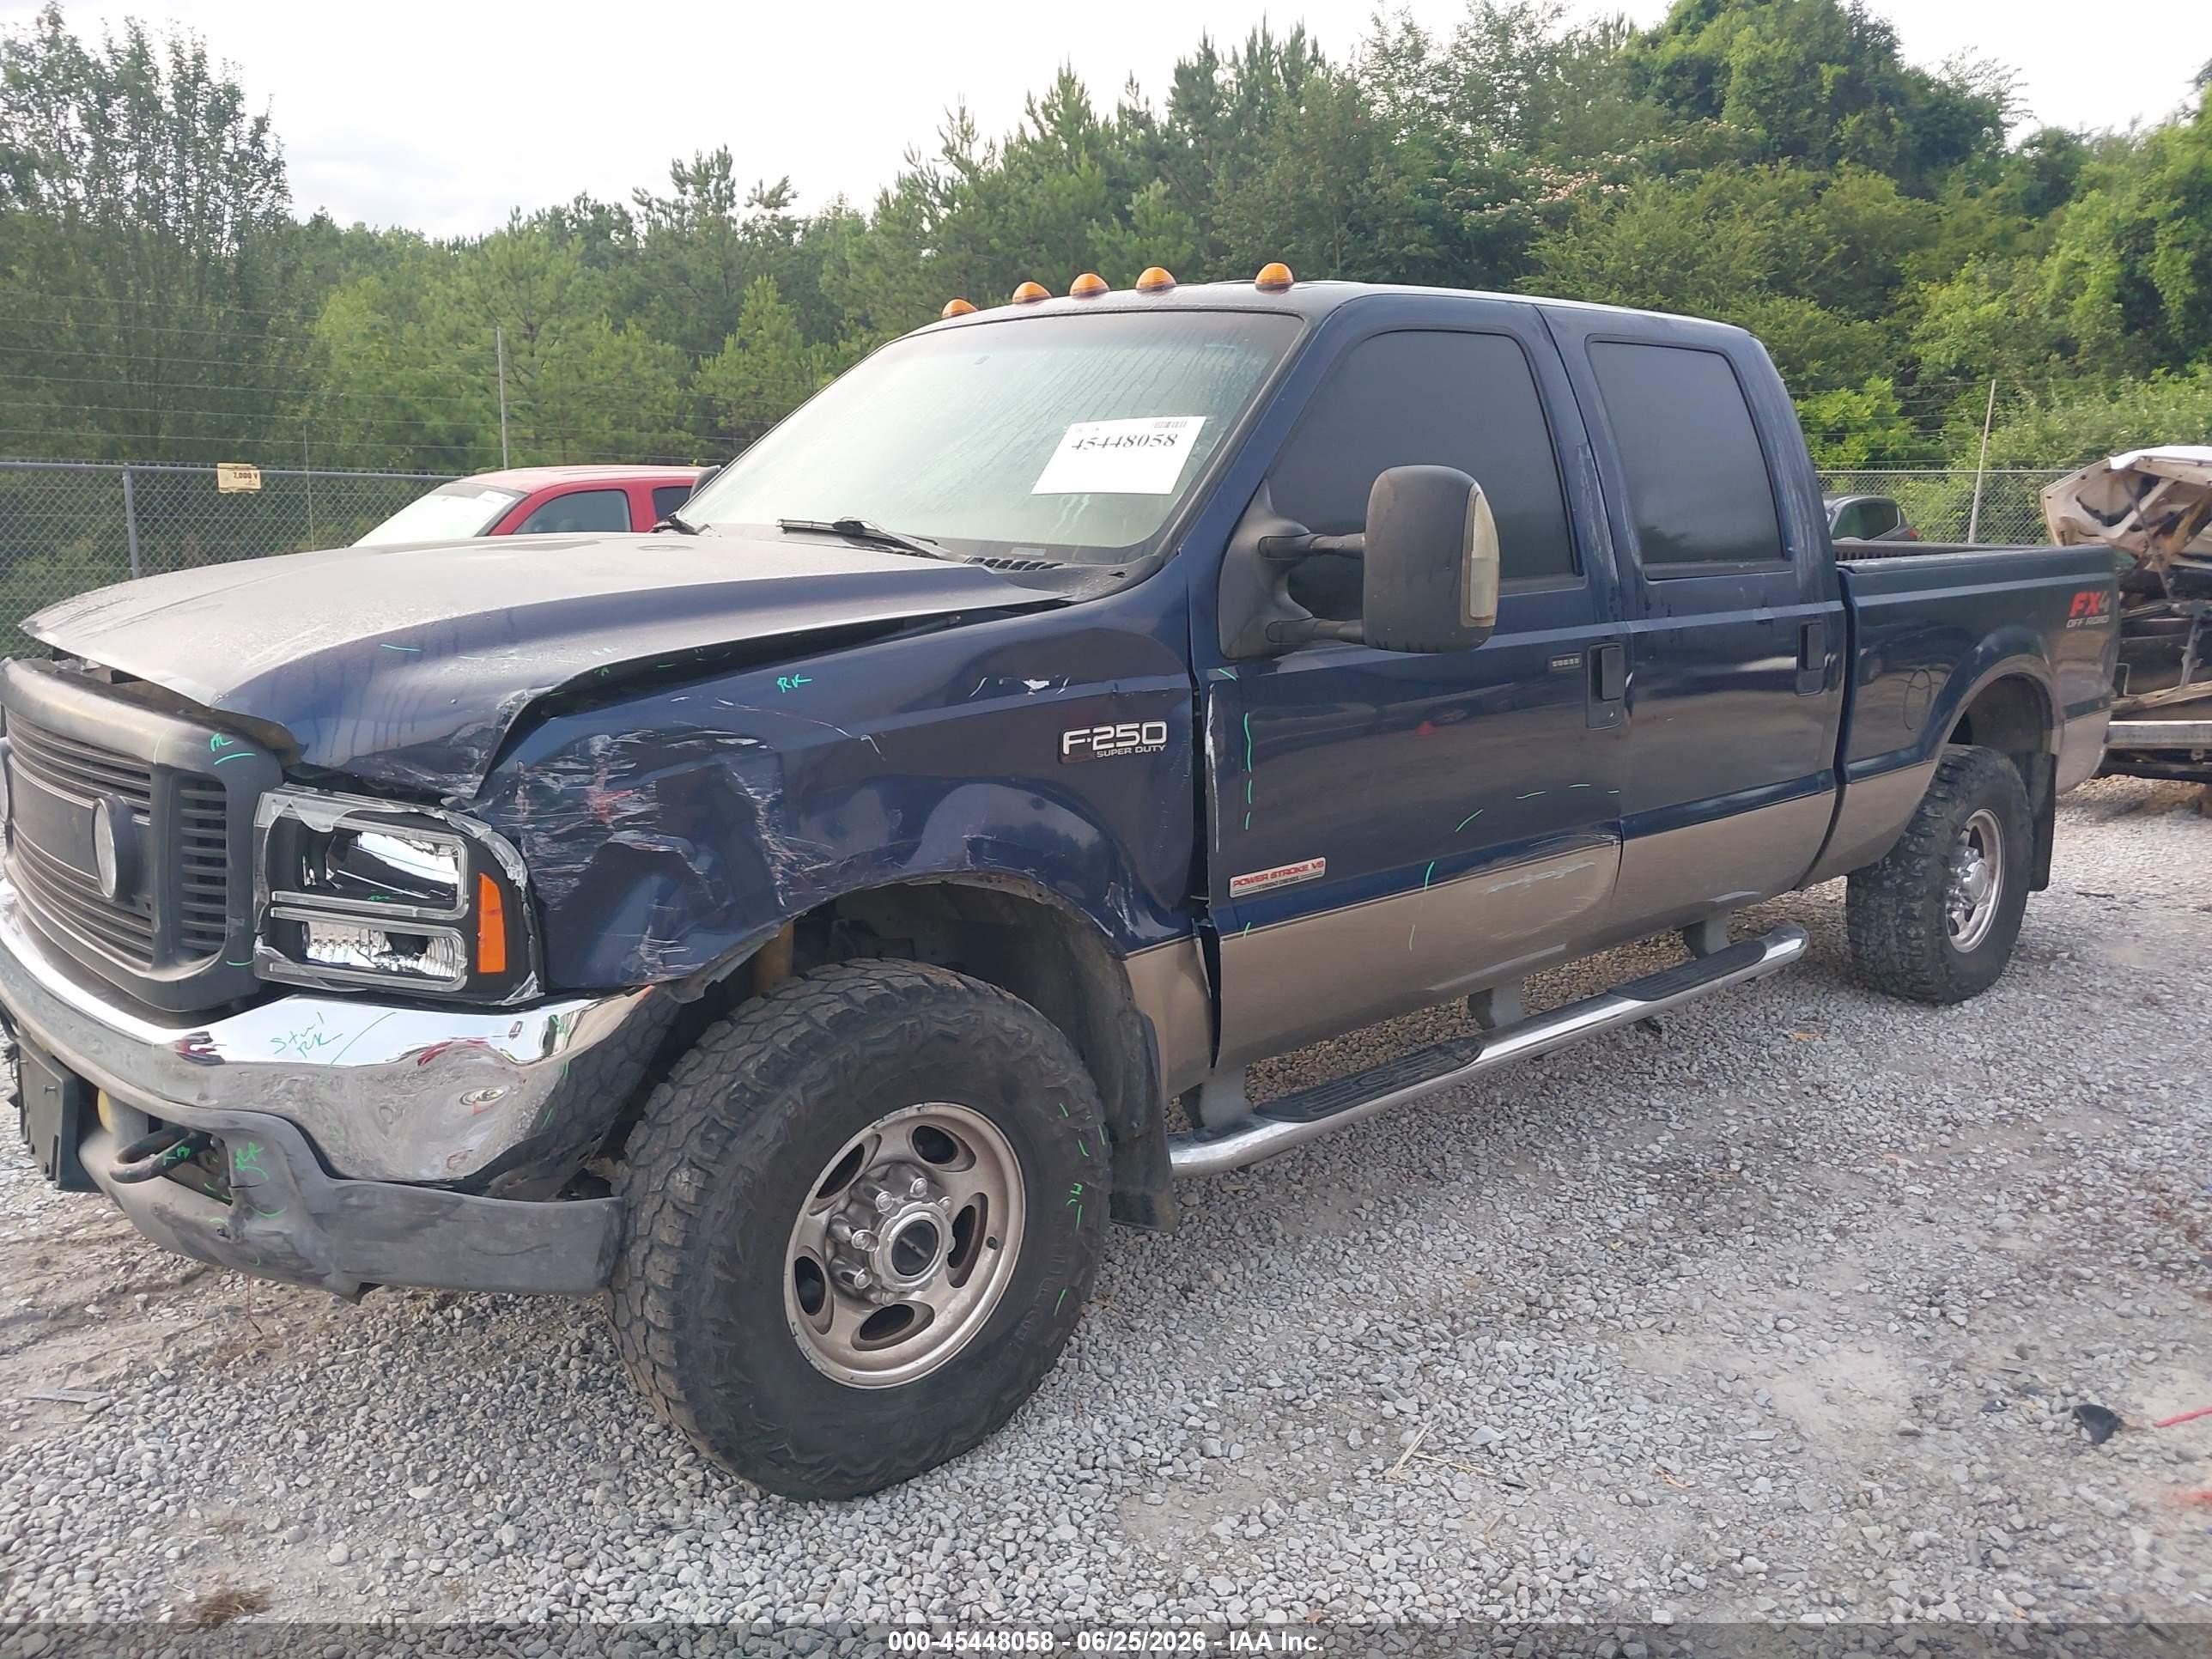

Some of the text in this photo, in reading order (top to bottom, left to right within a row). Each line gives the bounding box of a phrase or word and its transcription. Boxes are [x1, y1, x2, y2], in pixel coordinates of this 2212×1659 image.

[1071, 433, 1179, 451] 45448058
[2069, 590, 2111, 618] FX4
[1097, 744, 1166, 758] SUPER DUTY
[1232, 860, 1325, 888] POWER STROKE V8
